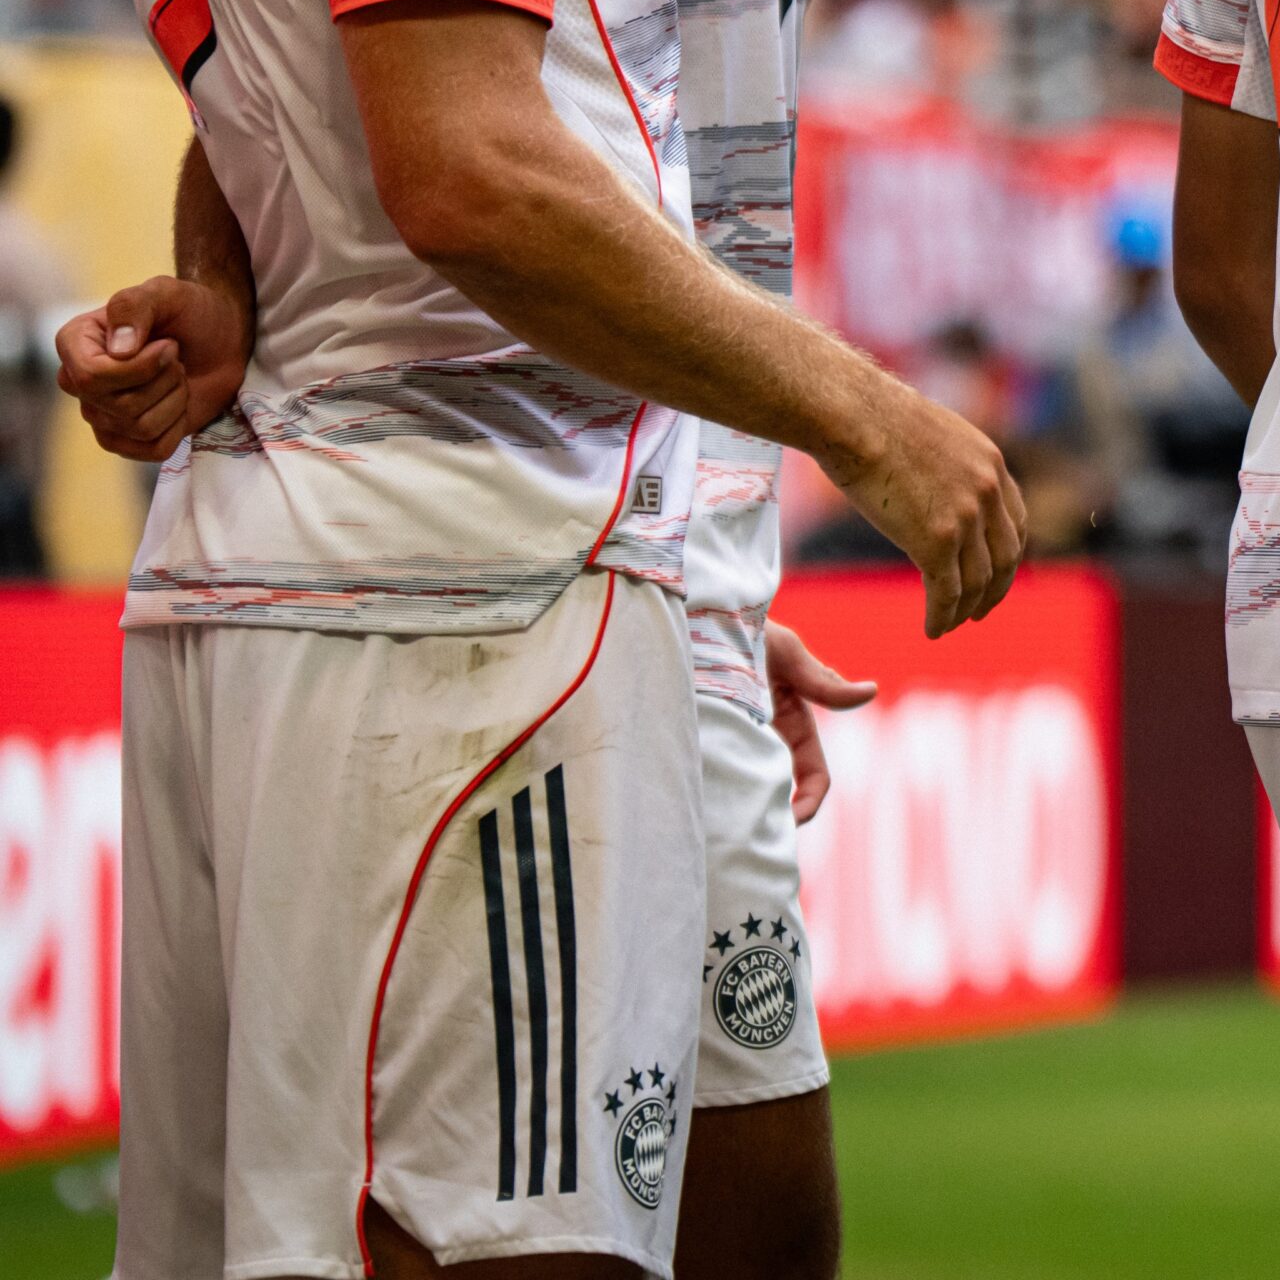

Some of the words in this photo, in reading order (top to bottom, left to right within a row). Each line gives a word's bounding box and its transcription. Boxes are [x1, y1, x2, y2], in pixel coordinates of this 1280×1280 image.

[721, 973, 739, 997] FC
[737, 952, 791, 984] BAYERN
[625, 1115, 642, 1140] FC
